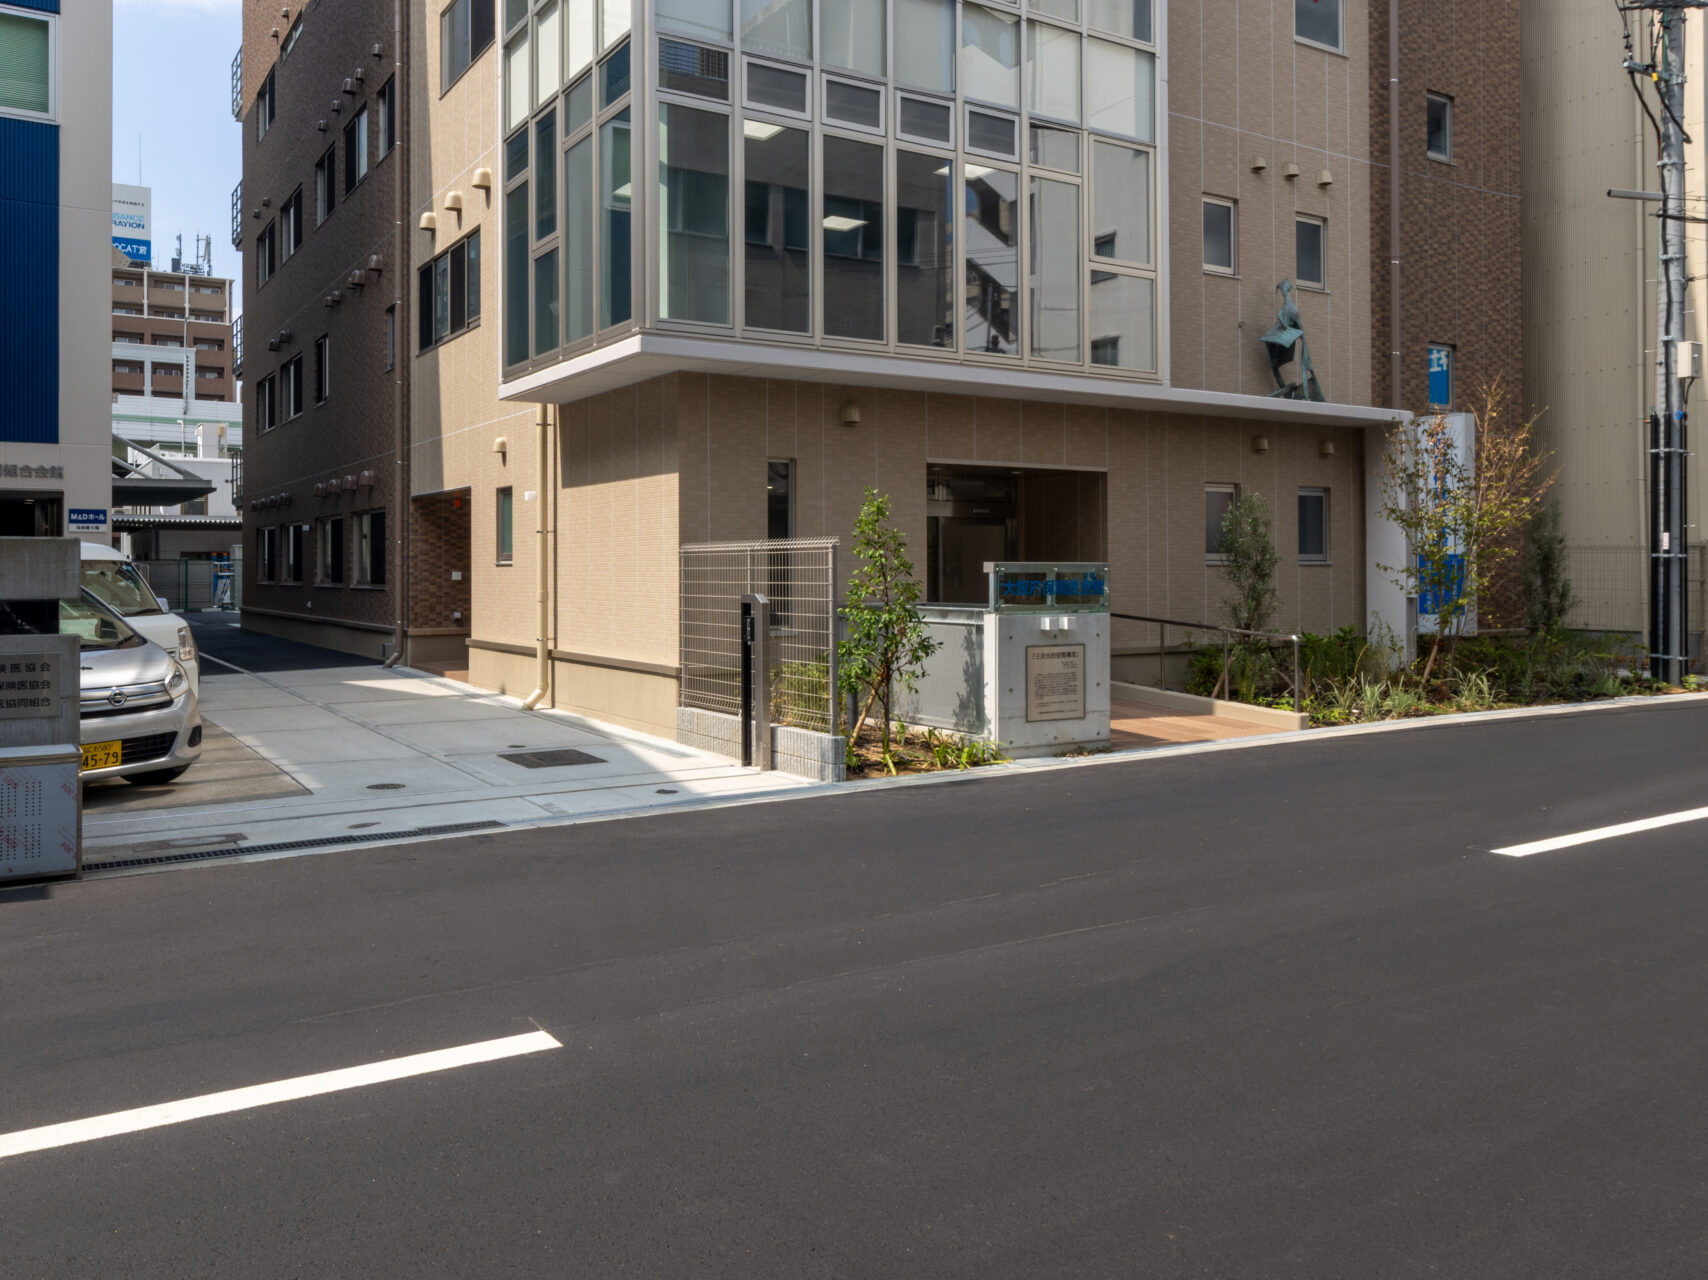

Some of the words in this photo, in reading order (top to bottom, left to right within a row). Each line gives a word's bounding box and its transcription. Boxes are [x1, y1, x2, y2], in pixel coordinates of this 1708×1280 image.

[0, 464, 64, 479] 組合会館
[82, 752, 119, 768] 45-79
